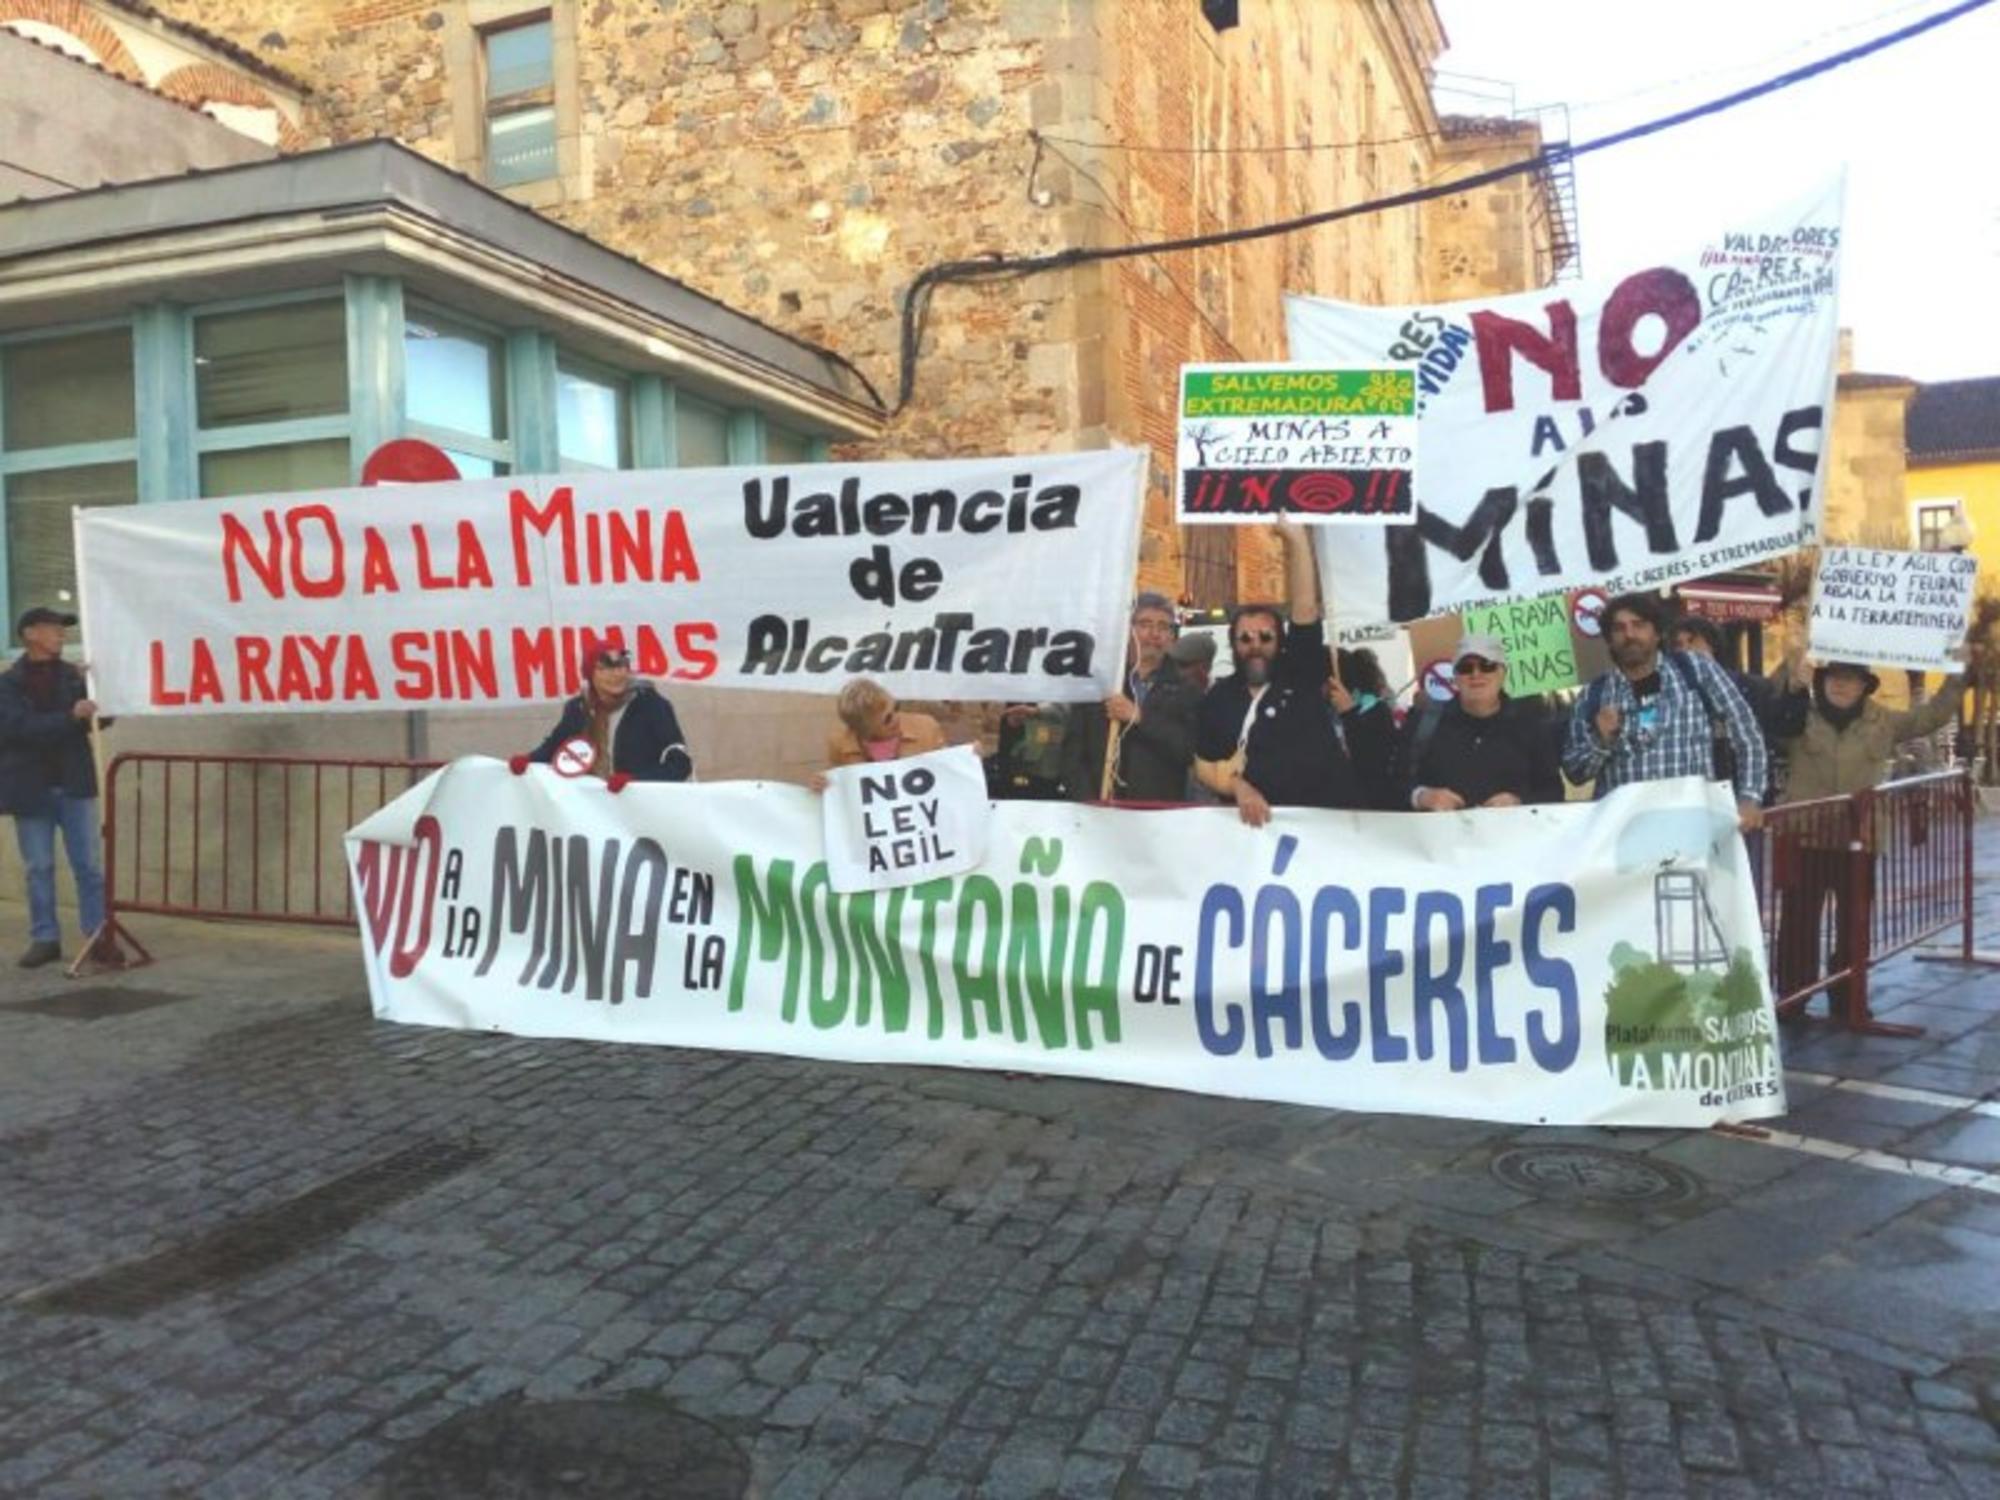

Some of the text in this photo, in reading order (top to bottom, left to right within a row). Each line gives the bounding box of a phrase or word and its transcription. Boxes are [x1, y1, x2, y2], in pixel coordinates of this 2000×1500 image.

[1470, 266, 1700, 412] NO
[1212, 374, 1338, 393] SALVEMOS
[1186, 397, 1365, 414] EXTREMADURA
[1247, 420, 1392, 441] MINAS A
[1531, 415, 1566, 458] A
[1214, 444, 1412, 467] CIELO ABIERTO
[220, 504, 345, 602] NO
[362, 526, 399, 595] A
[411, 519, 493, 591] LA
[1830, 551, 1849, 566] LA
[1857, 553, 1897, 568] LEY
[849, 544, 943, 607] de
[1879, 589, 1896, 603] LA
[1511, 602, 1566, 631] RAYA
[1829, 606, 1847, 621] LA
[1502, 632, 1539, 652] SIN
[149, 637, 224, 706] LA
[235, 633, 377, 703] RAYA
[390, 628, 497, 701] SIN
[1508, 651, 1575, 689] INAS
[860, 767, 936, 804] NO
[864, 798, 938, 838] LEY
[442, 848, 463, 900] A
[357, 815, 442, 980] NO
[474, 826, 669, 1005] MINA
[668, 867, 714, 925] EN
[442, 905, 482, 958] LA
[683, 933, 726, 990] LA
[1194, 834, 1581, 1073] CÁCERES
[1133, 944, 1184, 1006] DE
[1699, 1091, 1723, 1107] de
